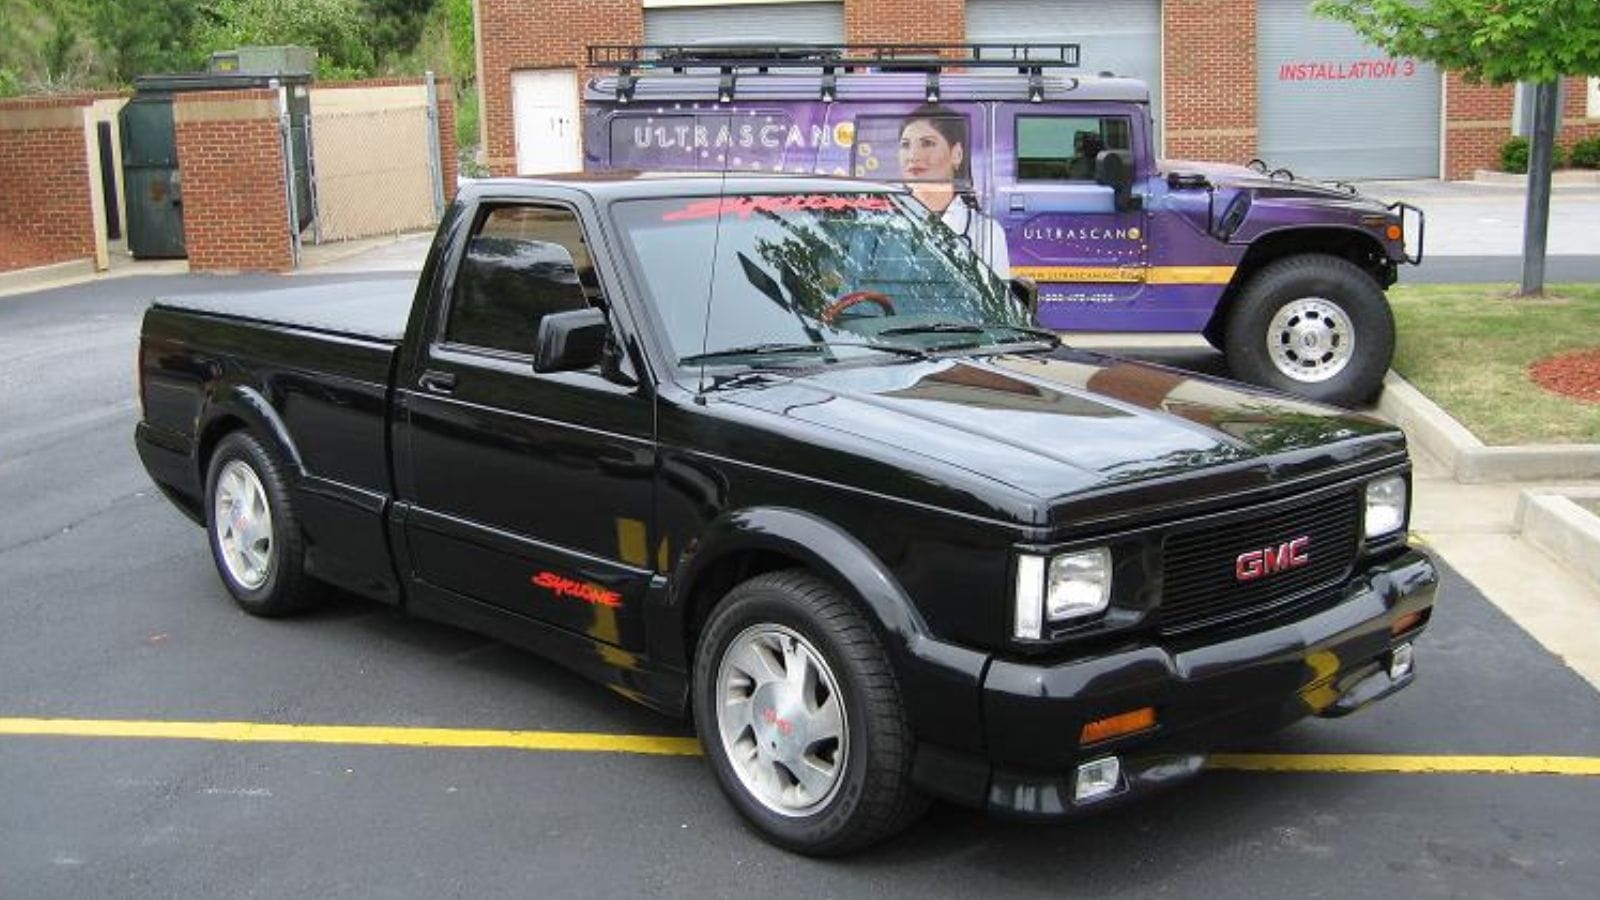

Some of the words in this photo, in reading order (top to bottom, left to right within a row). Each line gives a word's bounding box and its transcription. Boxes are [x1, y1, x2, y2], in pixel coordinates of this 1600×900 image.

[1279, 62, 1396, 80] INSTALLATION
[1403, 61, 1415, 77] 3
[633, 123, 829, 148] ULTRASCAN
[1024, 227, 1126, 240] ULTRASCAN
[1236, 536, 1309, 581] GMC
